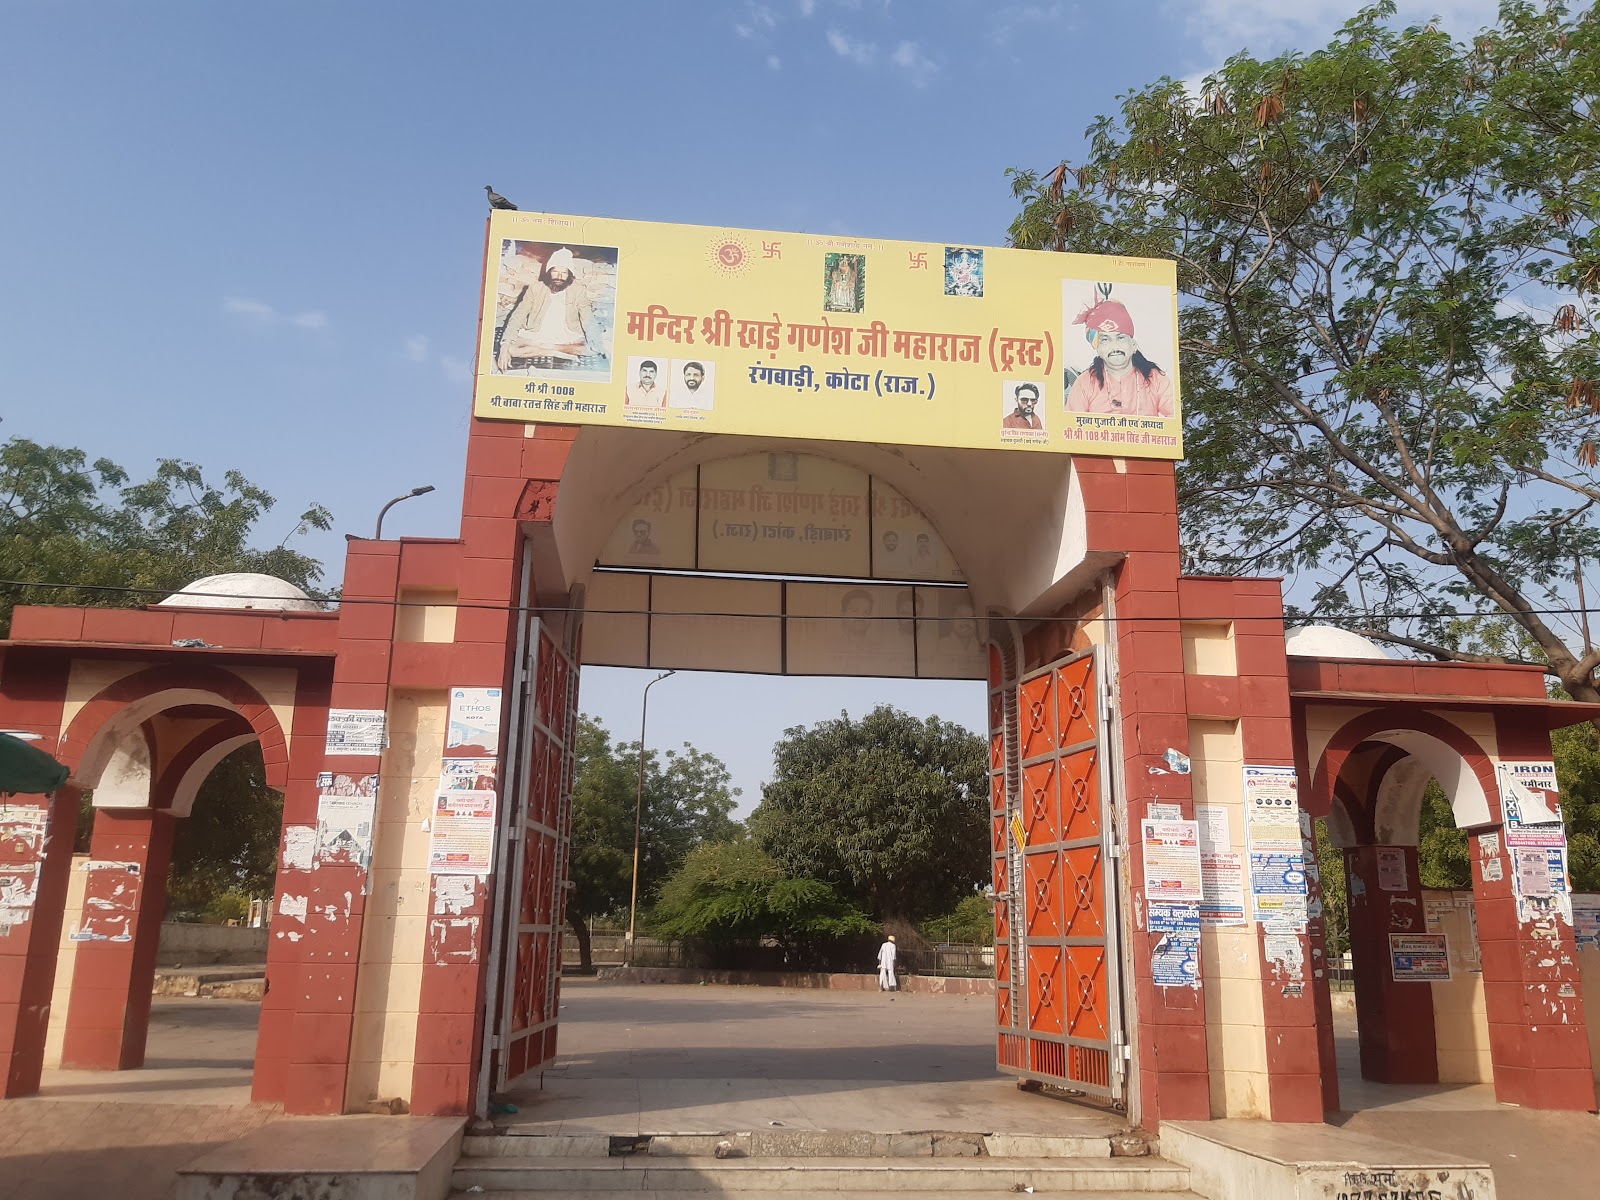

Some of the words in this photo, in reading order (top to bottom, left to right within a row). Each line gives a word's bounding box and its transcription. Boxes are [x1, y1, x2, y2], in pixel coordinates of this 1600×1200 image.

[626, 304, 698, 345] मन्दिर
[700, 309, 734, 348] श्री
[736, 313, 782, 360] खड़े
[787, 316, 854, 356] गणेश
[856, 320, 889, 358] जी
[892, 330, 982, 364] महाराज
[988, 327, 1055, 376] (ट्रस्ट)
[524, 381, 536, 394] श्री
[537, 382, 549, 395] श्री
[550, 385, 575, 396] 1008
[748, 361, 821, 393] रंगबाड़ी,
[825, 367, 871, 392] कोटा
[875, 369, 936, 400] (राज.)
[490, 395, 502, 407] श्री
[503, 397, 522, 409] बाबा
[543, 398, 561, 411] सिंह
[561, 399, 574, 412] जी
[574, 402, 608, 414] महाराज
[1075, 416, 1093, 427] मुख्य
[1094, 416, 1116, 428] पुजारी
[1117, 417, 1128, 428] जी
[1140, 419, 1165, 430] अध्यक्ष
[1063, 427, 1073, 440] श्री
[1073, 428, 1083, 441] श्री
[1084, 430, 1099, 441] 108
[1100, 429, 1110, 442] श्री
[1126, 430, 1140, 444] सिंह
[1140, 431, 1151, 445] जी
[1151, 434, 1178, 447] महाराज
[1514, 765, 1553, 773] IRON
[1148, 908, 1171, 917] सम्यक
